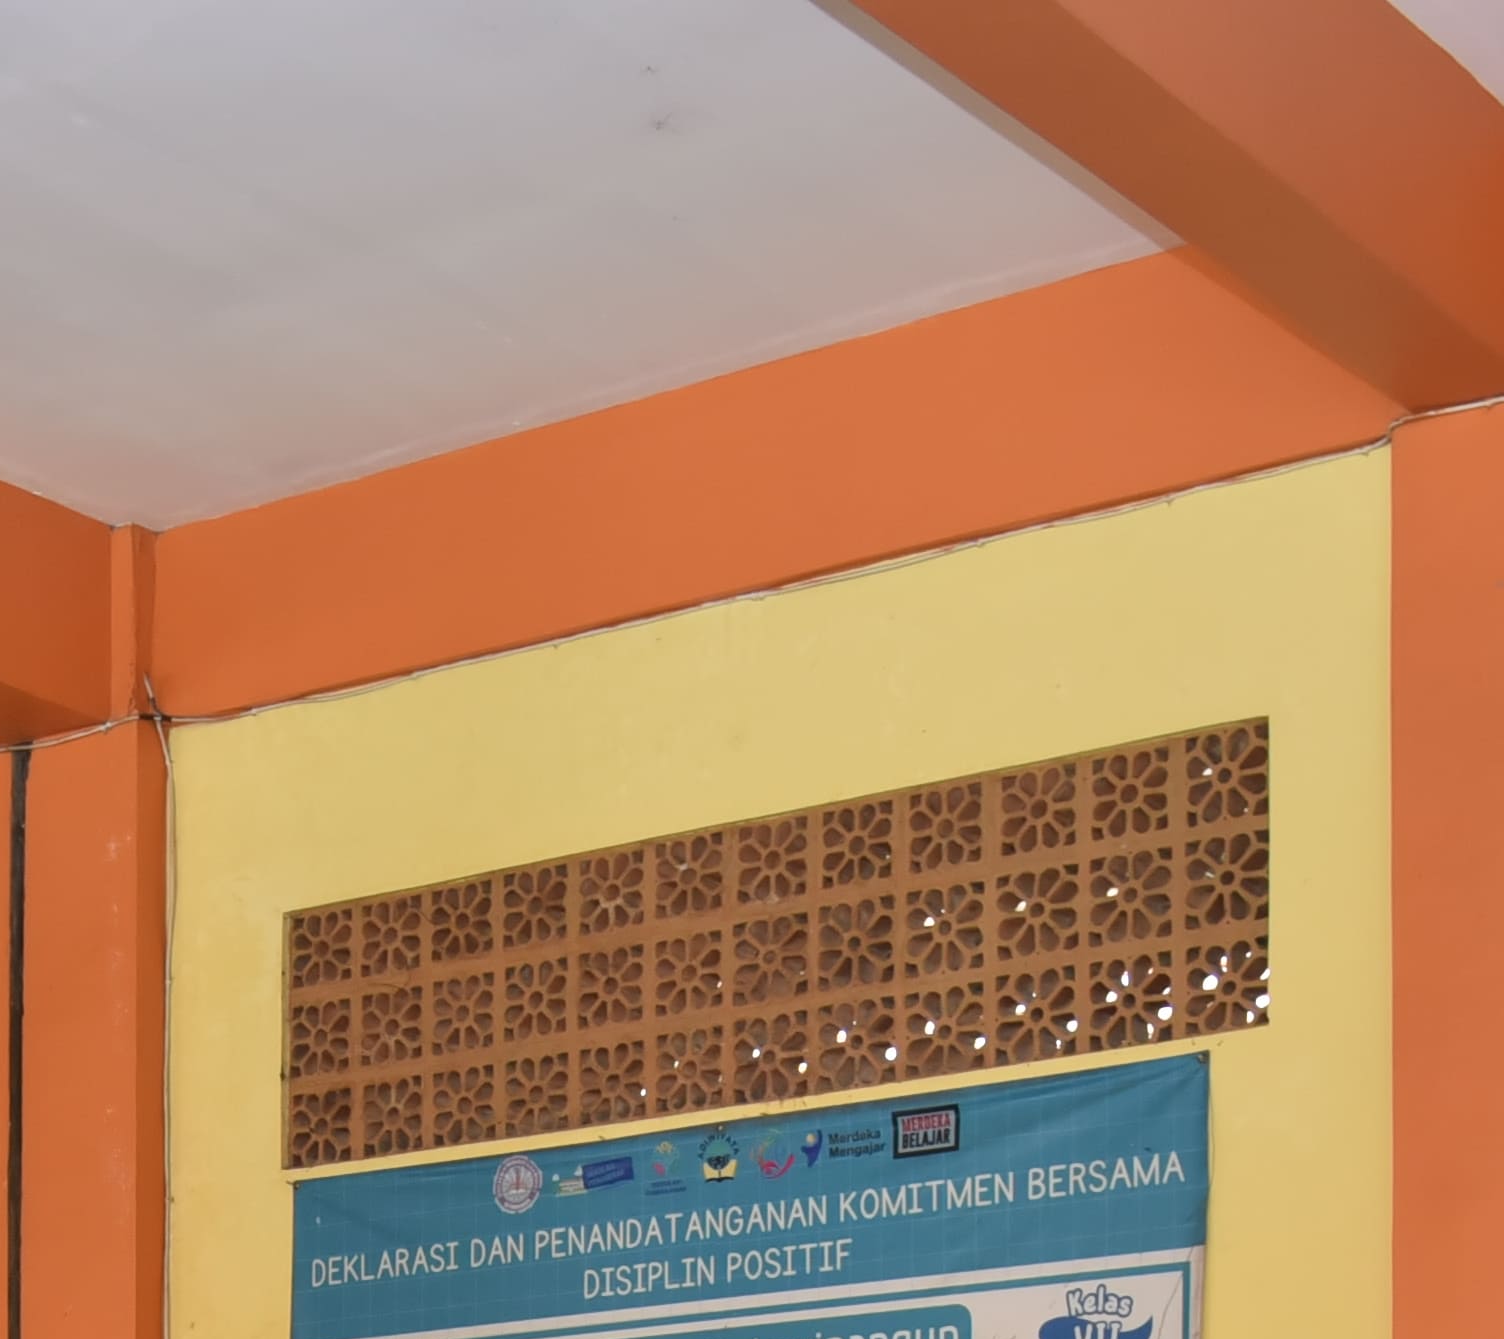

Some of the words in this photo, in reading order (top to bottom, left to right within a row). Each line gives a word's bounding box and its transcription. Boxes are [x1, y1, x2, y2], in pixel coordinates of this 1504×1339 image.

[902, 1113, 952, 1133] MERDEKA
[828, 1128, 883, 1145] Merdeka
[902, 1127, 952, 1148] BELAJAR
[829, 1140, 886, 1159] Mengajar
[311, 1237, 459, 1288] DEKLARASI
[470, 1232, 526, 1269] DAN
[534, 1196, 829, 1257] PENANDATANGANAN
[838, 1173, 1018, 1223] KOMITMEN
[1028, 1151, 1185, 1202] BERSAMA
[582, 1255, 717, 1299] DISIPLIN
[726, 1240, 853, 1285] POSITIF
[1066, 1284, 1133, 1318] Kelas
